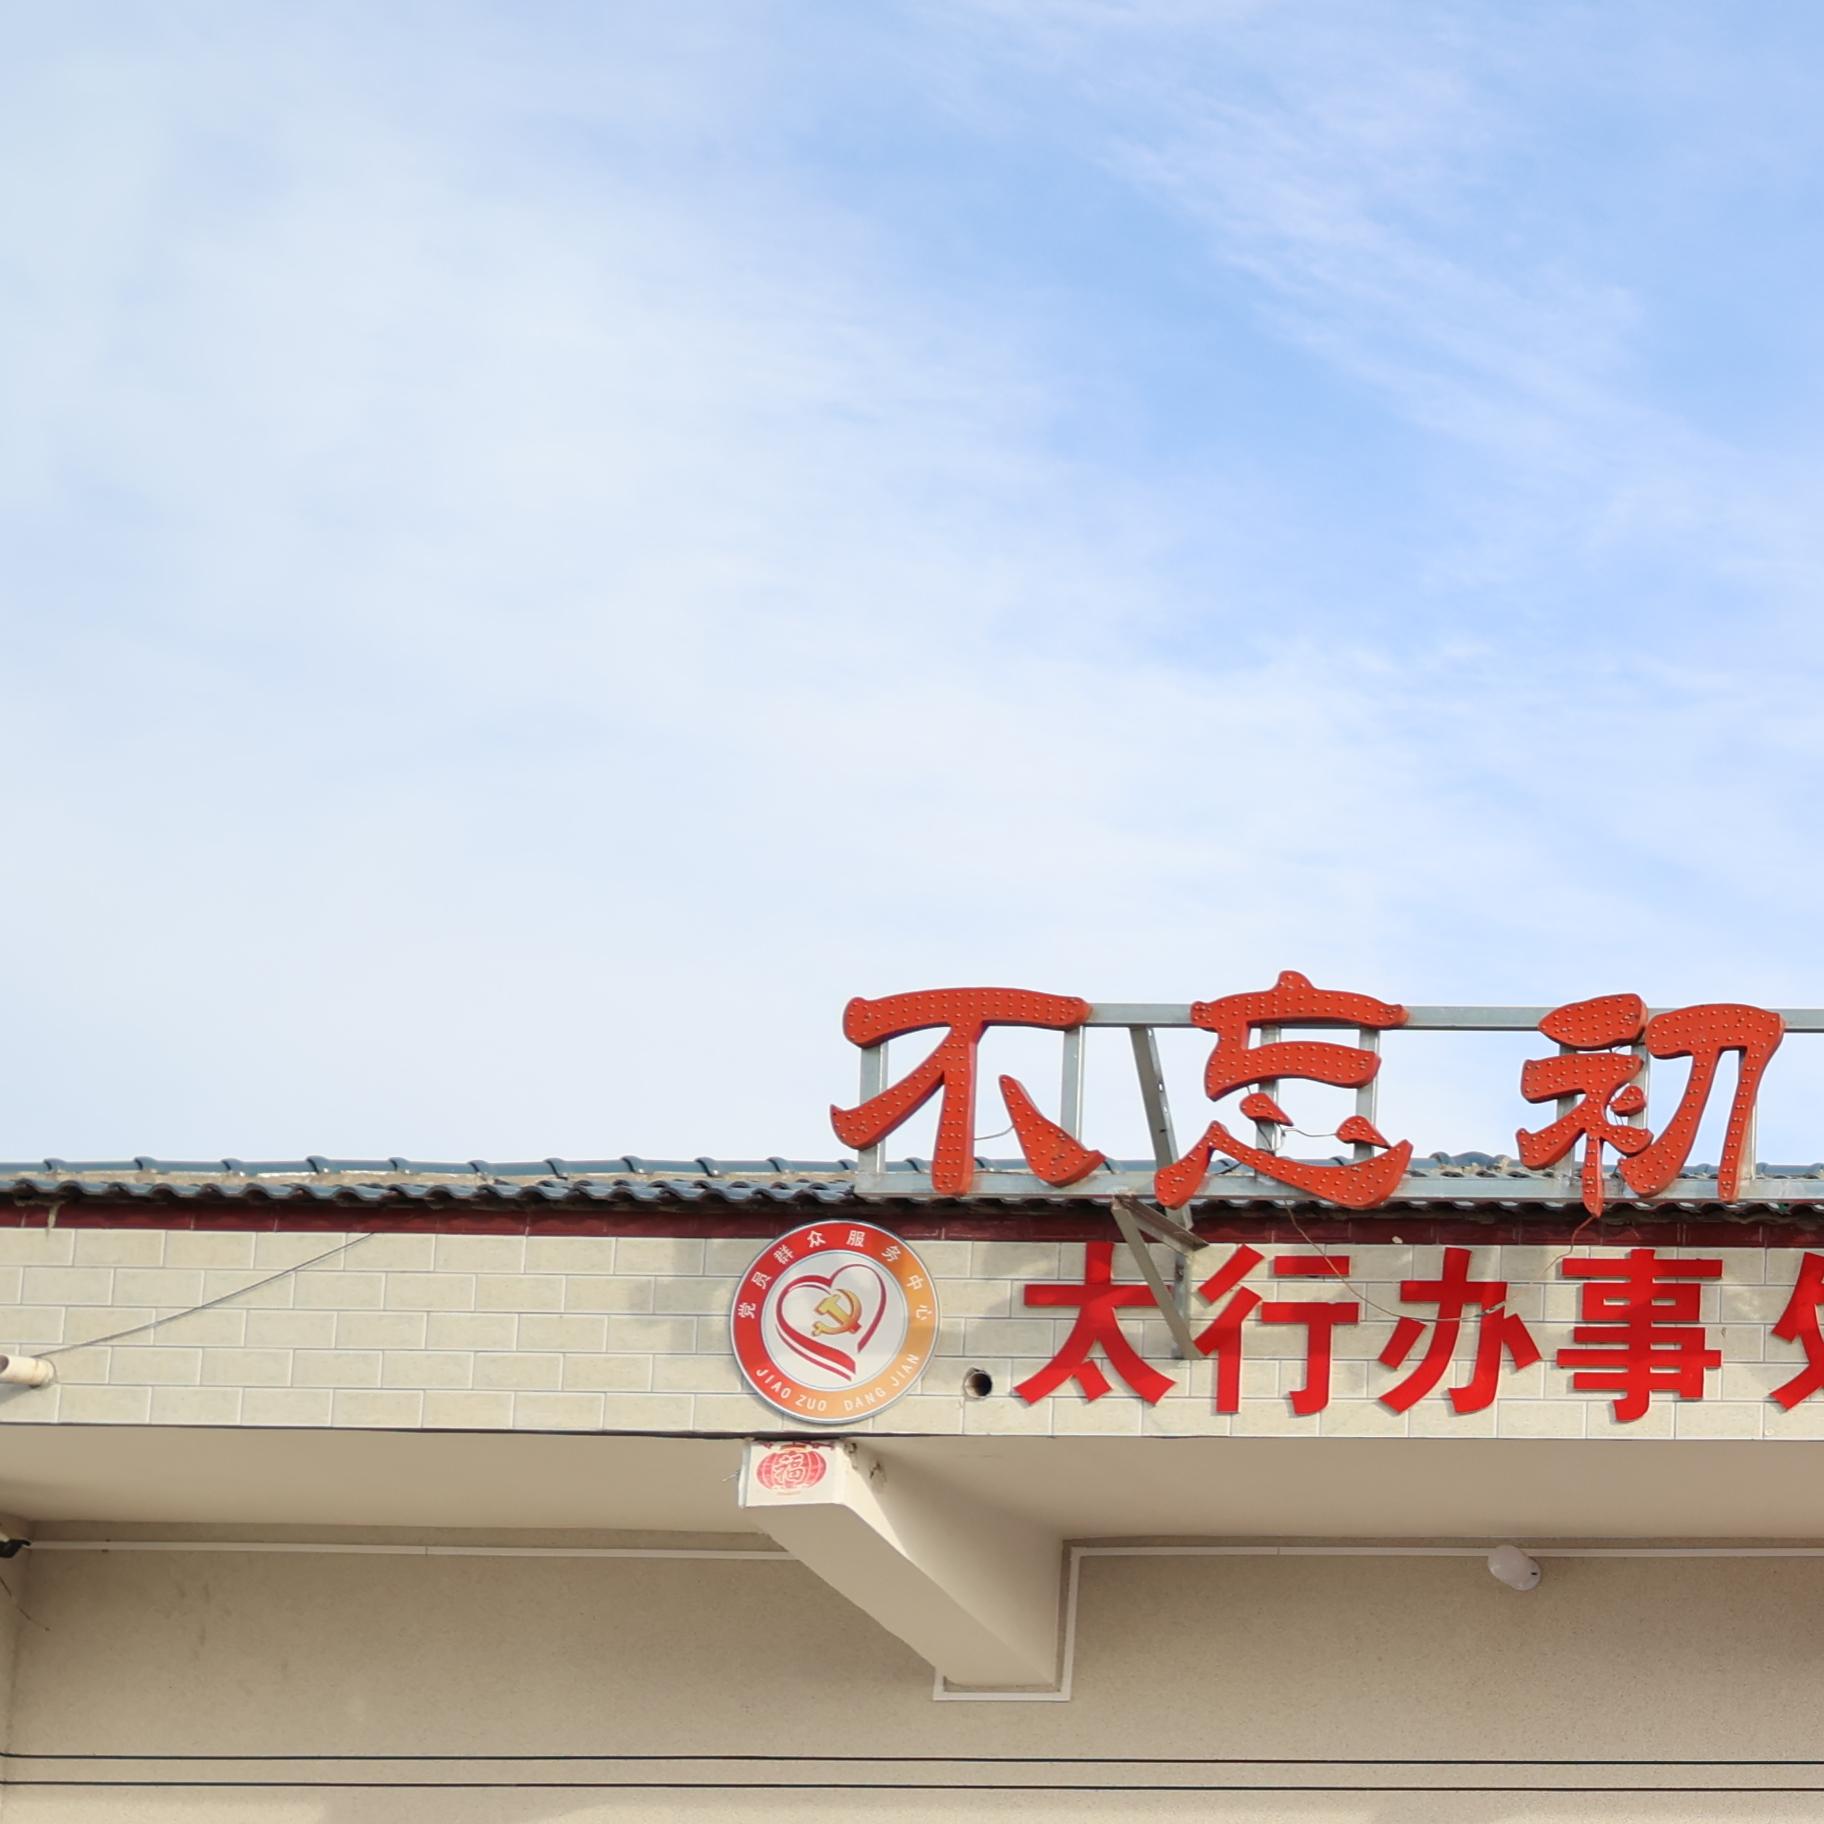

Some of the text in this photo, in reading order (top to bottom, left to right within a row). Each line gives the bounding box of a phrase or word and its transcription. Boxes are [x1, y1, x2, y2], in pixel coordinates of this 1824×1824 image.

[738, 1229, 932, 1321] 党员群众服务中心
[756, 1353, 920, 1412] JIAO ZUO DANG JIAN
